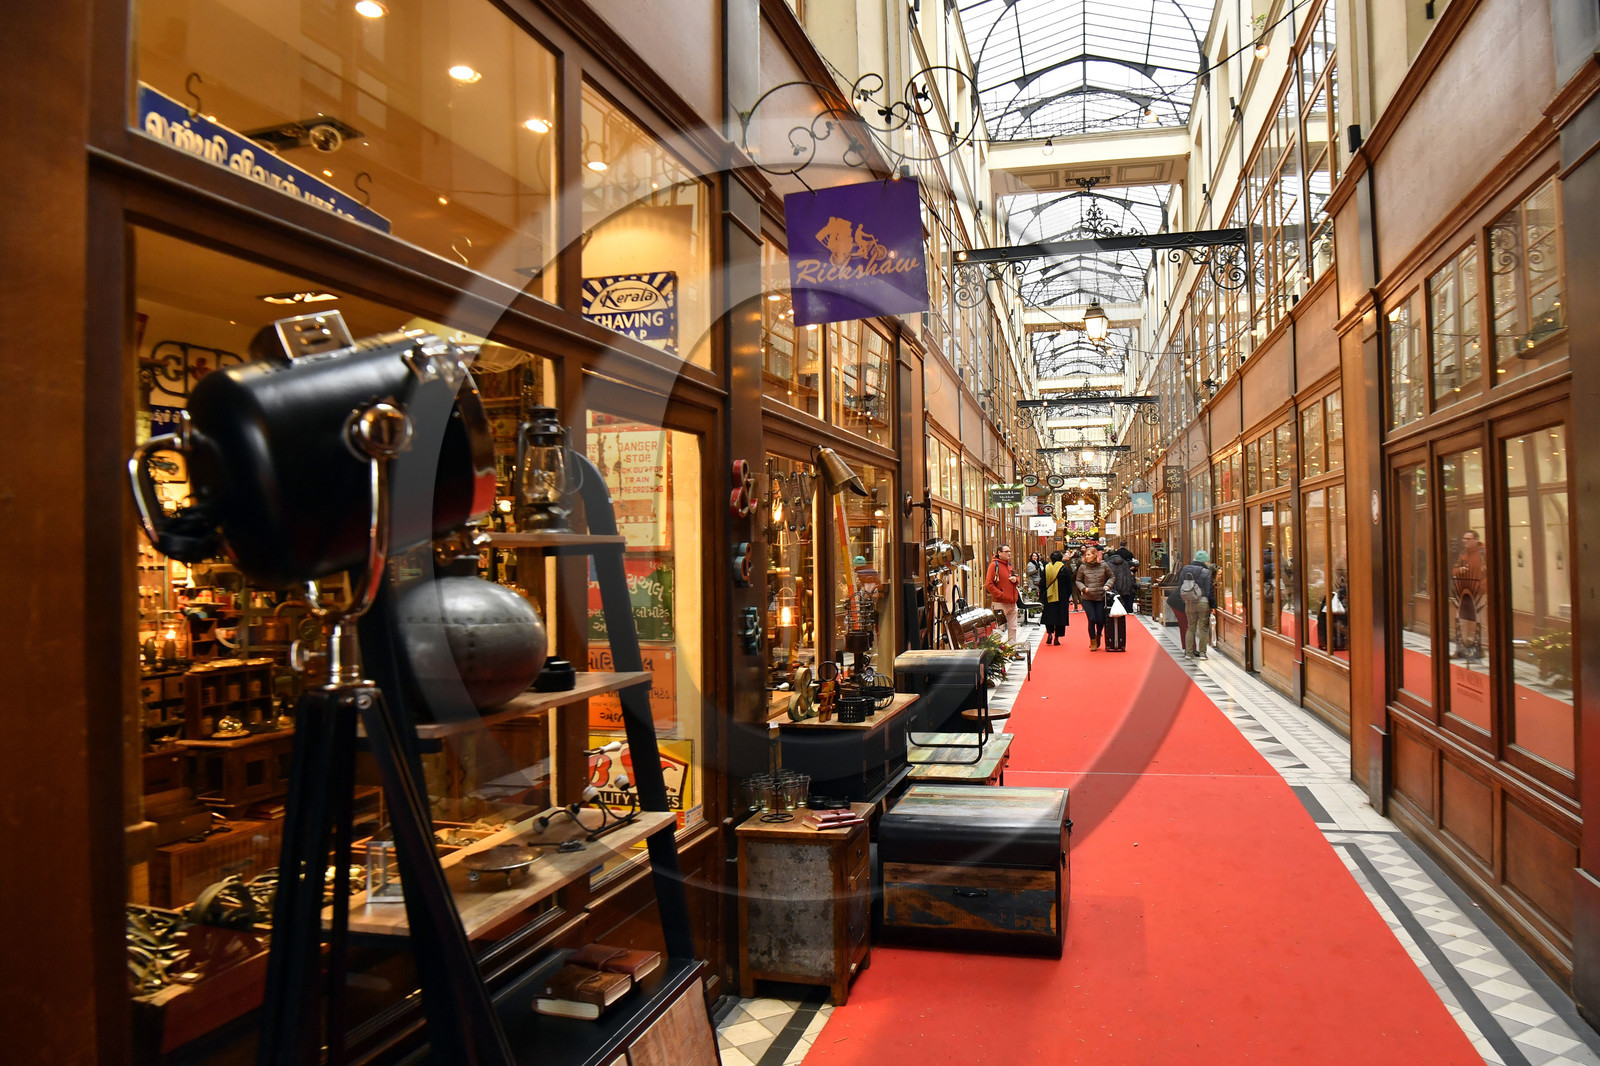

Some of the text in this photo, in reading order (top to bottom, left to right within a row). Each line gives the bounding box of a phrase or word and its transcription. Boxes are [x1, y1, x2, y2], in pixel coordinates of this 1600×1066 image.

[796, 252, 920, 284] Rickshaw
[602, 288, 653, 307] Kerala
[618, 441, 657, 452] DANGER
[625, 476, 649, 484] TRAIN
